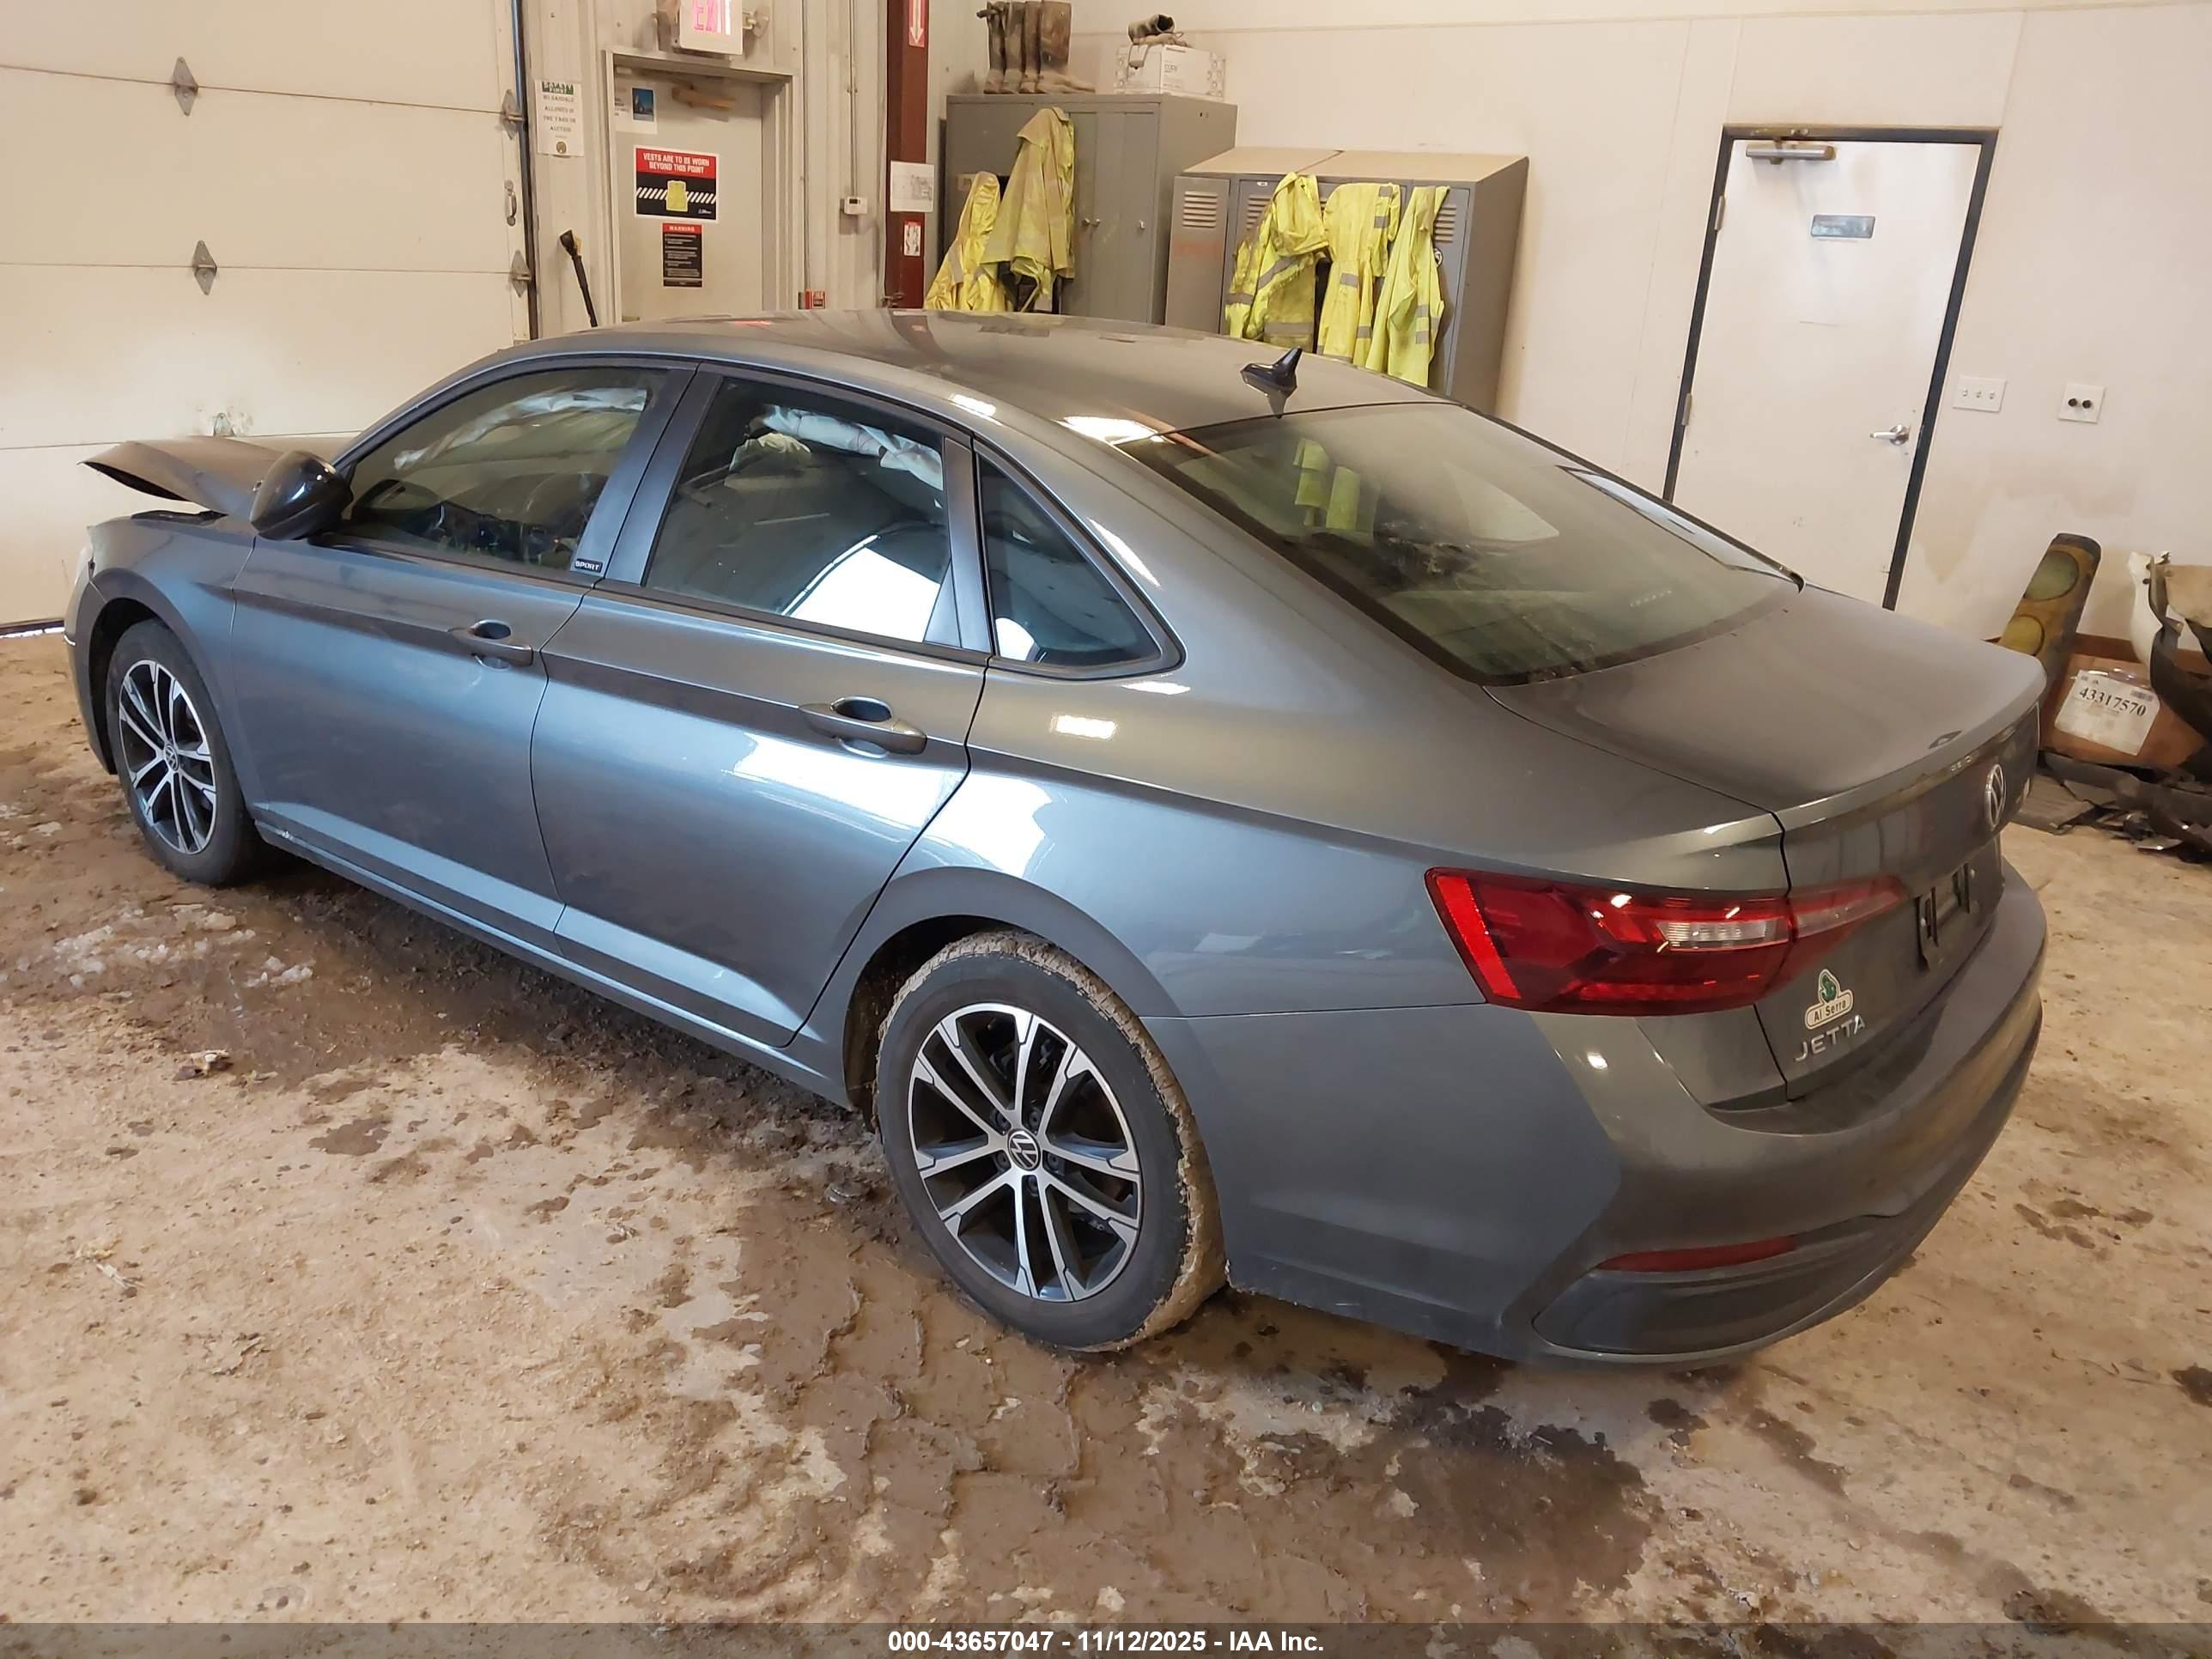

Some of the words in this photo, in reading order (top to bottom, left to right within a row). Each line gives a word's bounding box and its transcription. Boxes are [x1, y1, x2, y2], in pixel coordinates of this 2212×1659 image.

[642, 152, 662, 161] VESTS
[662, 155, 674, 163] ARE
[675, 155, 683, 164] TO
[692, 157, 710, 167] WORN
[648, 161, 672, 171] BEYOND
[673, 163, 686, 173] THIS
[575, 561, 600, 571] SPORT
[2078, 686, 2148, 718] 43317570
[1825, 999, 1847, 1017] Serra
[1794, 1014, 1866, 1062] JETTA
